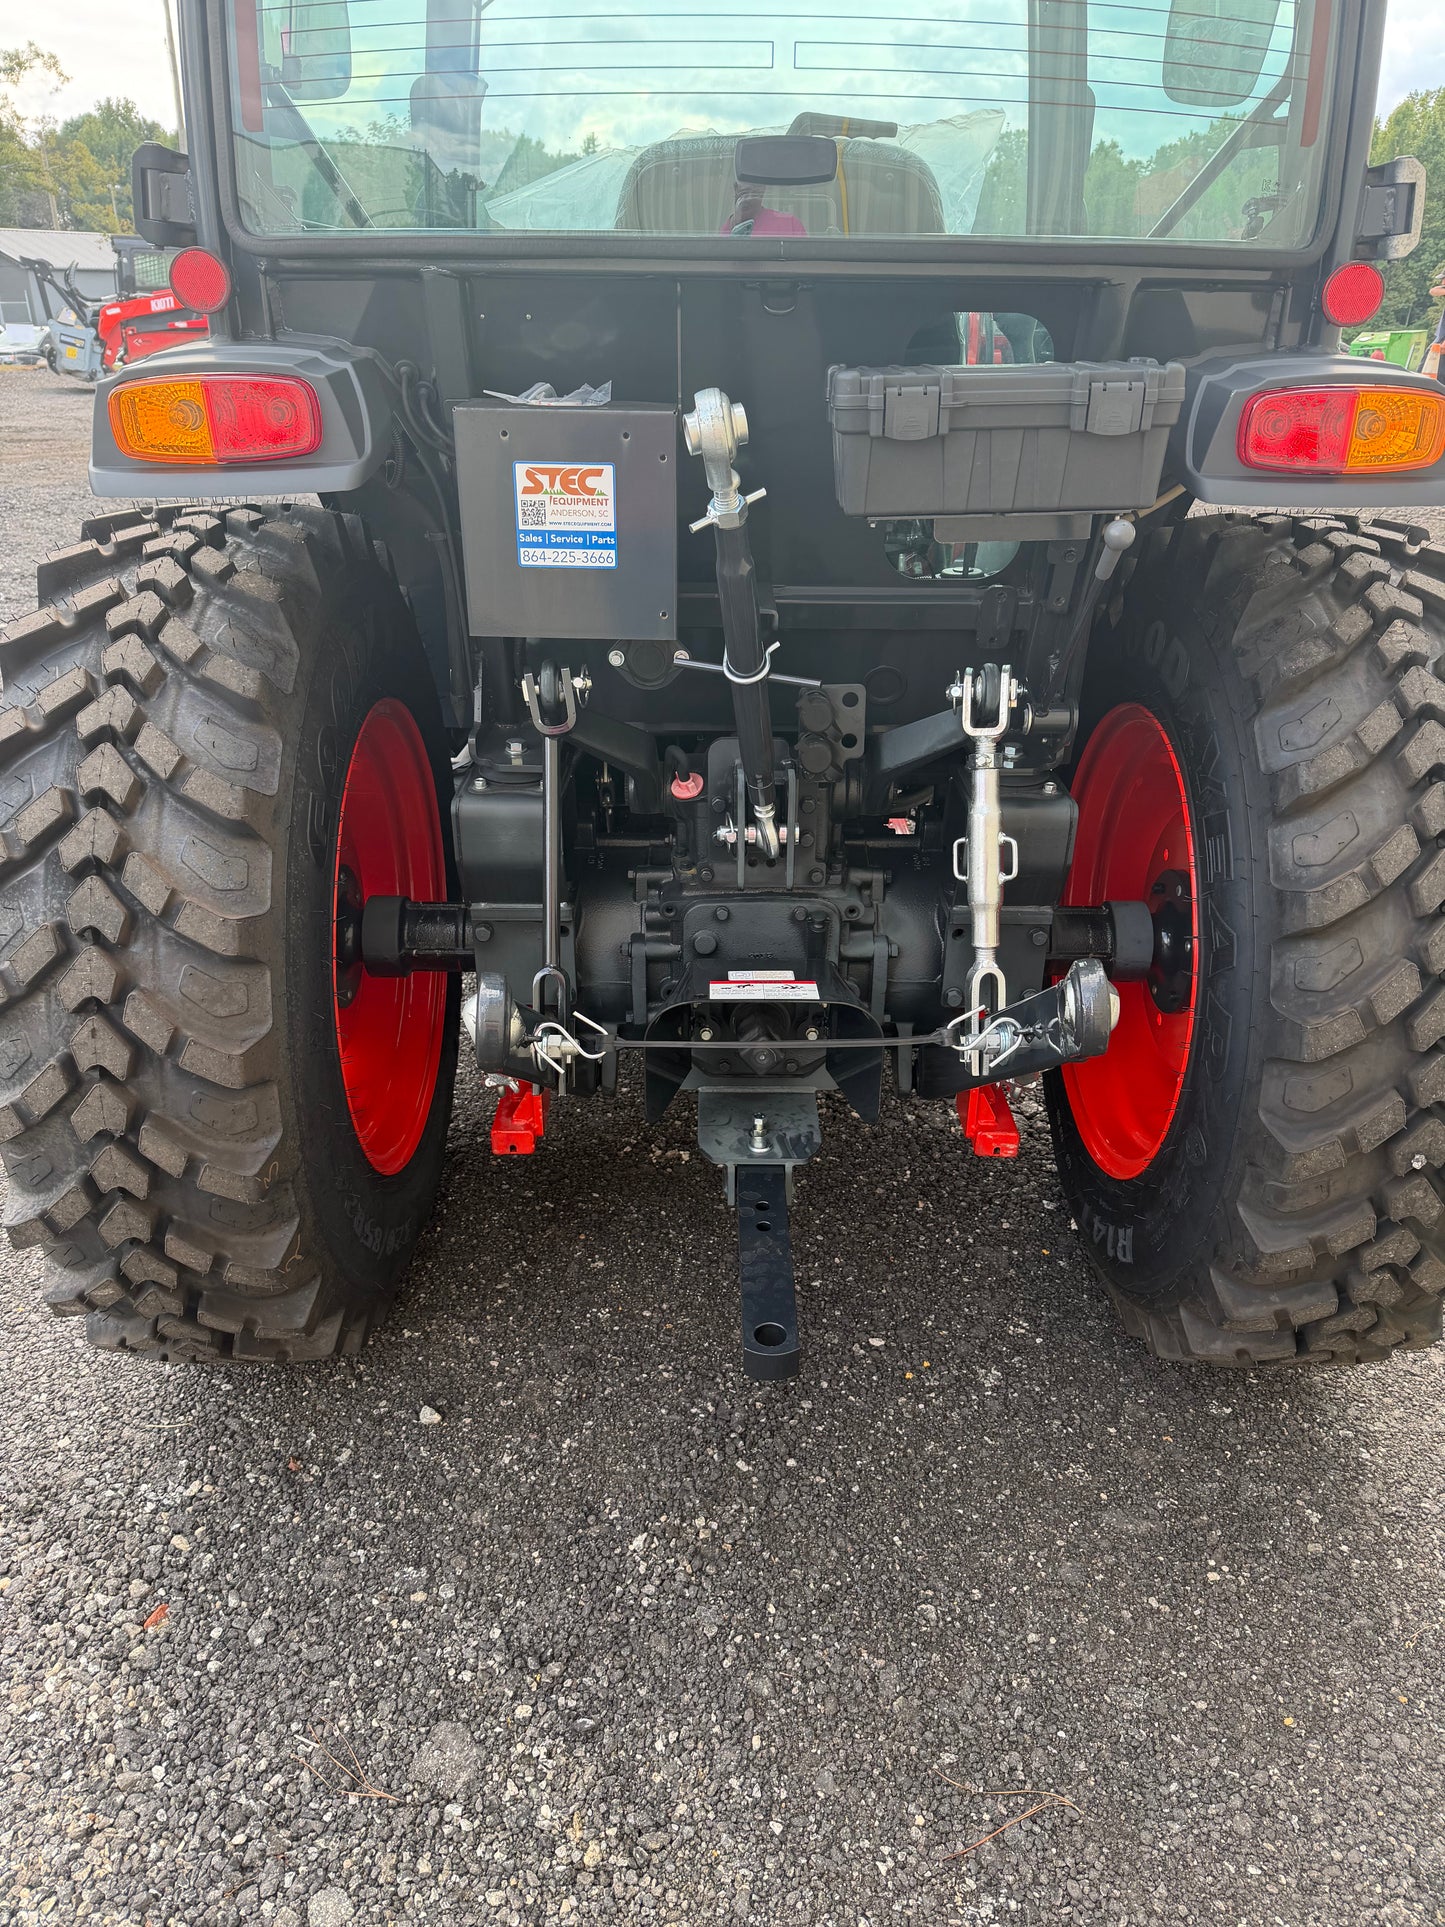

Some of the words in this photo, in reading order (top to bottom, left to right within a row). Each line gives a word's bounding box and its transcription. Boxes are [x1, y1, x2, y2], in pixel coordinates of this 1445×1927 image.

[522, 467, 604, 496] STEC
[552, 497, 609, 506] EQUIPMENT
[551, 509, 597, 518] ANDERSON,
[520, 533, 543, 542] Sales
[550, 534, 584, 543] Service
[592, 535, 615, 544] Parts
[522, 550, 613, 564] 864-225-3666
